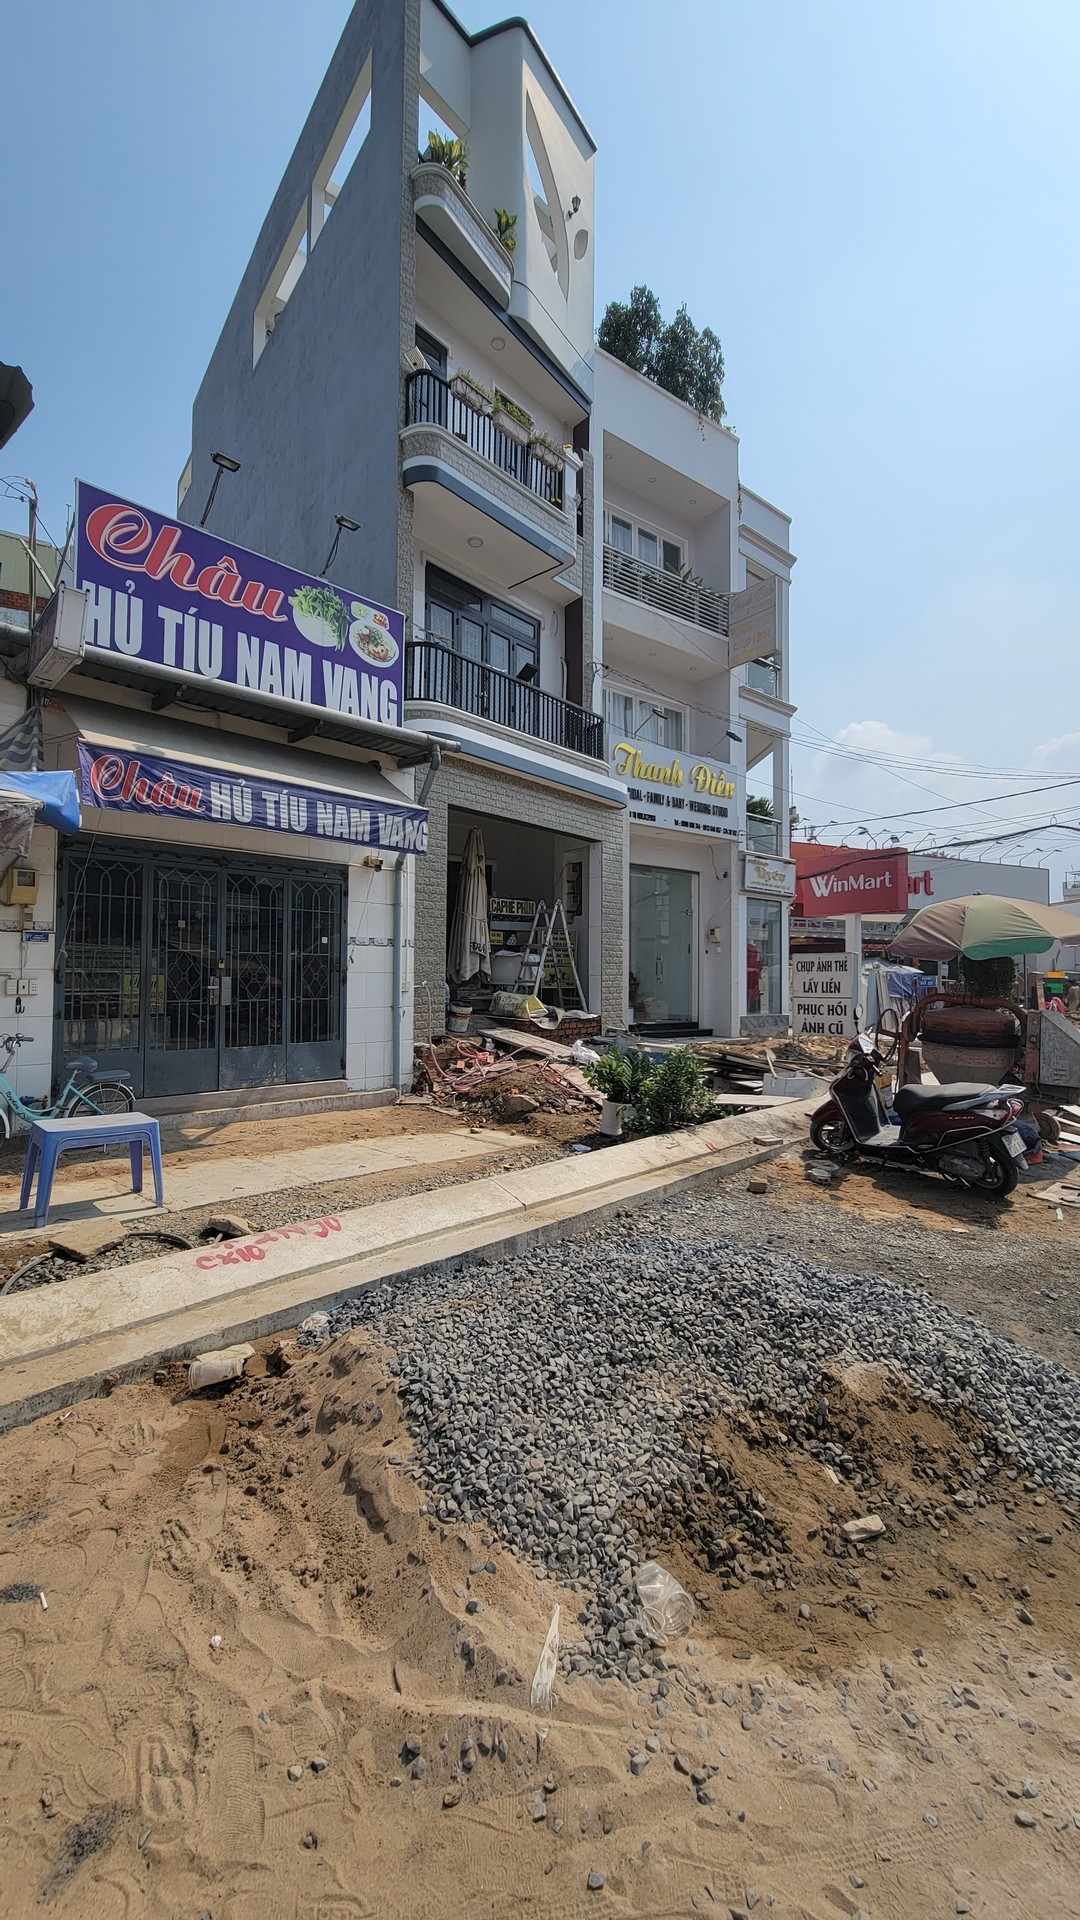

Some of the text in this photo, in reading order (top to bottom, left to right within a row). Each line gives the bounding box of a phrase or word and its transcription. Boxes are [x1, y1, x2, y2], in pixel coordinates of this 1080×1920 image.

[86, 503, 288, 623] Châu
[82, 580, 398, 727] HỦ TÍU NAM VANG
[614, 742, 684, 787] Thanh
[90, 754, 428, 854] Châu HỦ TÍU NAM VANG
[689, 799, 711, 814] WEDDING
[712, 804, 728, 818] STUDIO
[810, 871, 893, 897] WinMart
[517, 901, 535, 915] PHIN
[796, 956, 848, 975] CHỤP ẢNH THẺ
[803, 978, 818, 993] LẤY
[797, 1003, 825, 1018] PHỤC
[801, 1019, 843, 1035] ẢNH CŨ
